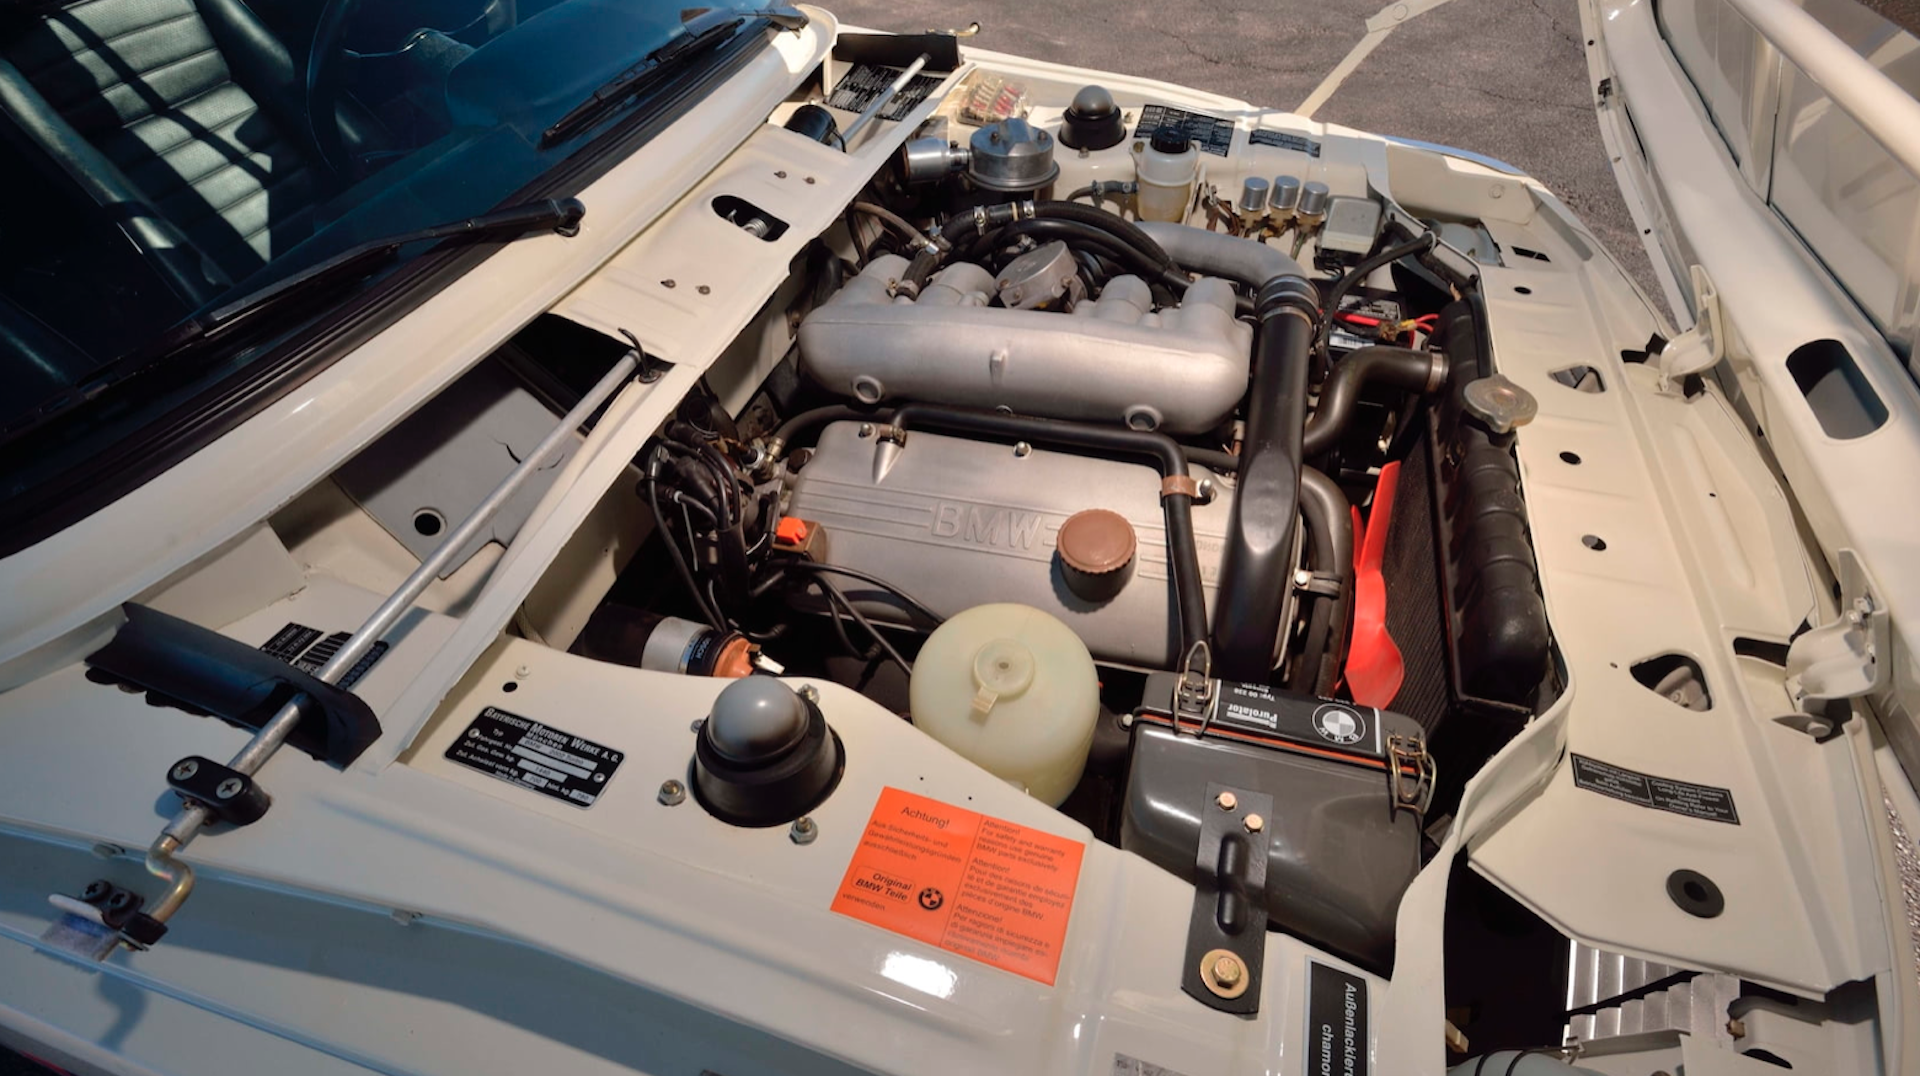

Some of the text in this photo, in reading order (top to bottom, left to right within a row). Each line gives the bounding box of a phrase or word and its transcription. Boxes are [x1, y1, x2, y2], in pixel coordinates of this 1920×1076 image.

[931, 502, 1041, 550] BMW
[1228, 703, 1278, 723] Purolator
[526, 731, 563, 750] München
[571, 737, 603, 756] WERKE
[901, 807, 950, 829] Achtung!
[983, 820, 1021, 834] Attention!
[888, 824, 931, 843] Sicherheits-
[933, 840, 948, 848] und
[981, 828, 1065, 858] For safety and warranty
[976, 843, 996, 854] BMW
[1024, 849, 1054, 862] genuine
[969, 865, 987, 877] Pour
[972, 857, 1010, 873] Attention!
[856, 878, 907, 901] BMW Teile
[873, 873, 912, 891] Original
[842, 893, 885, 911] verwenden
[957, 904, 1003, 923] Attenzione!
[953, 912, 967, 921] Per
[1005, 929, 1044, 947] sicurezza
